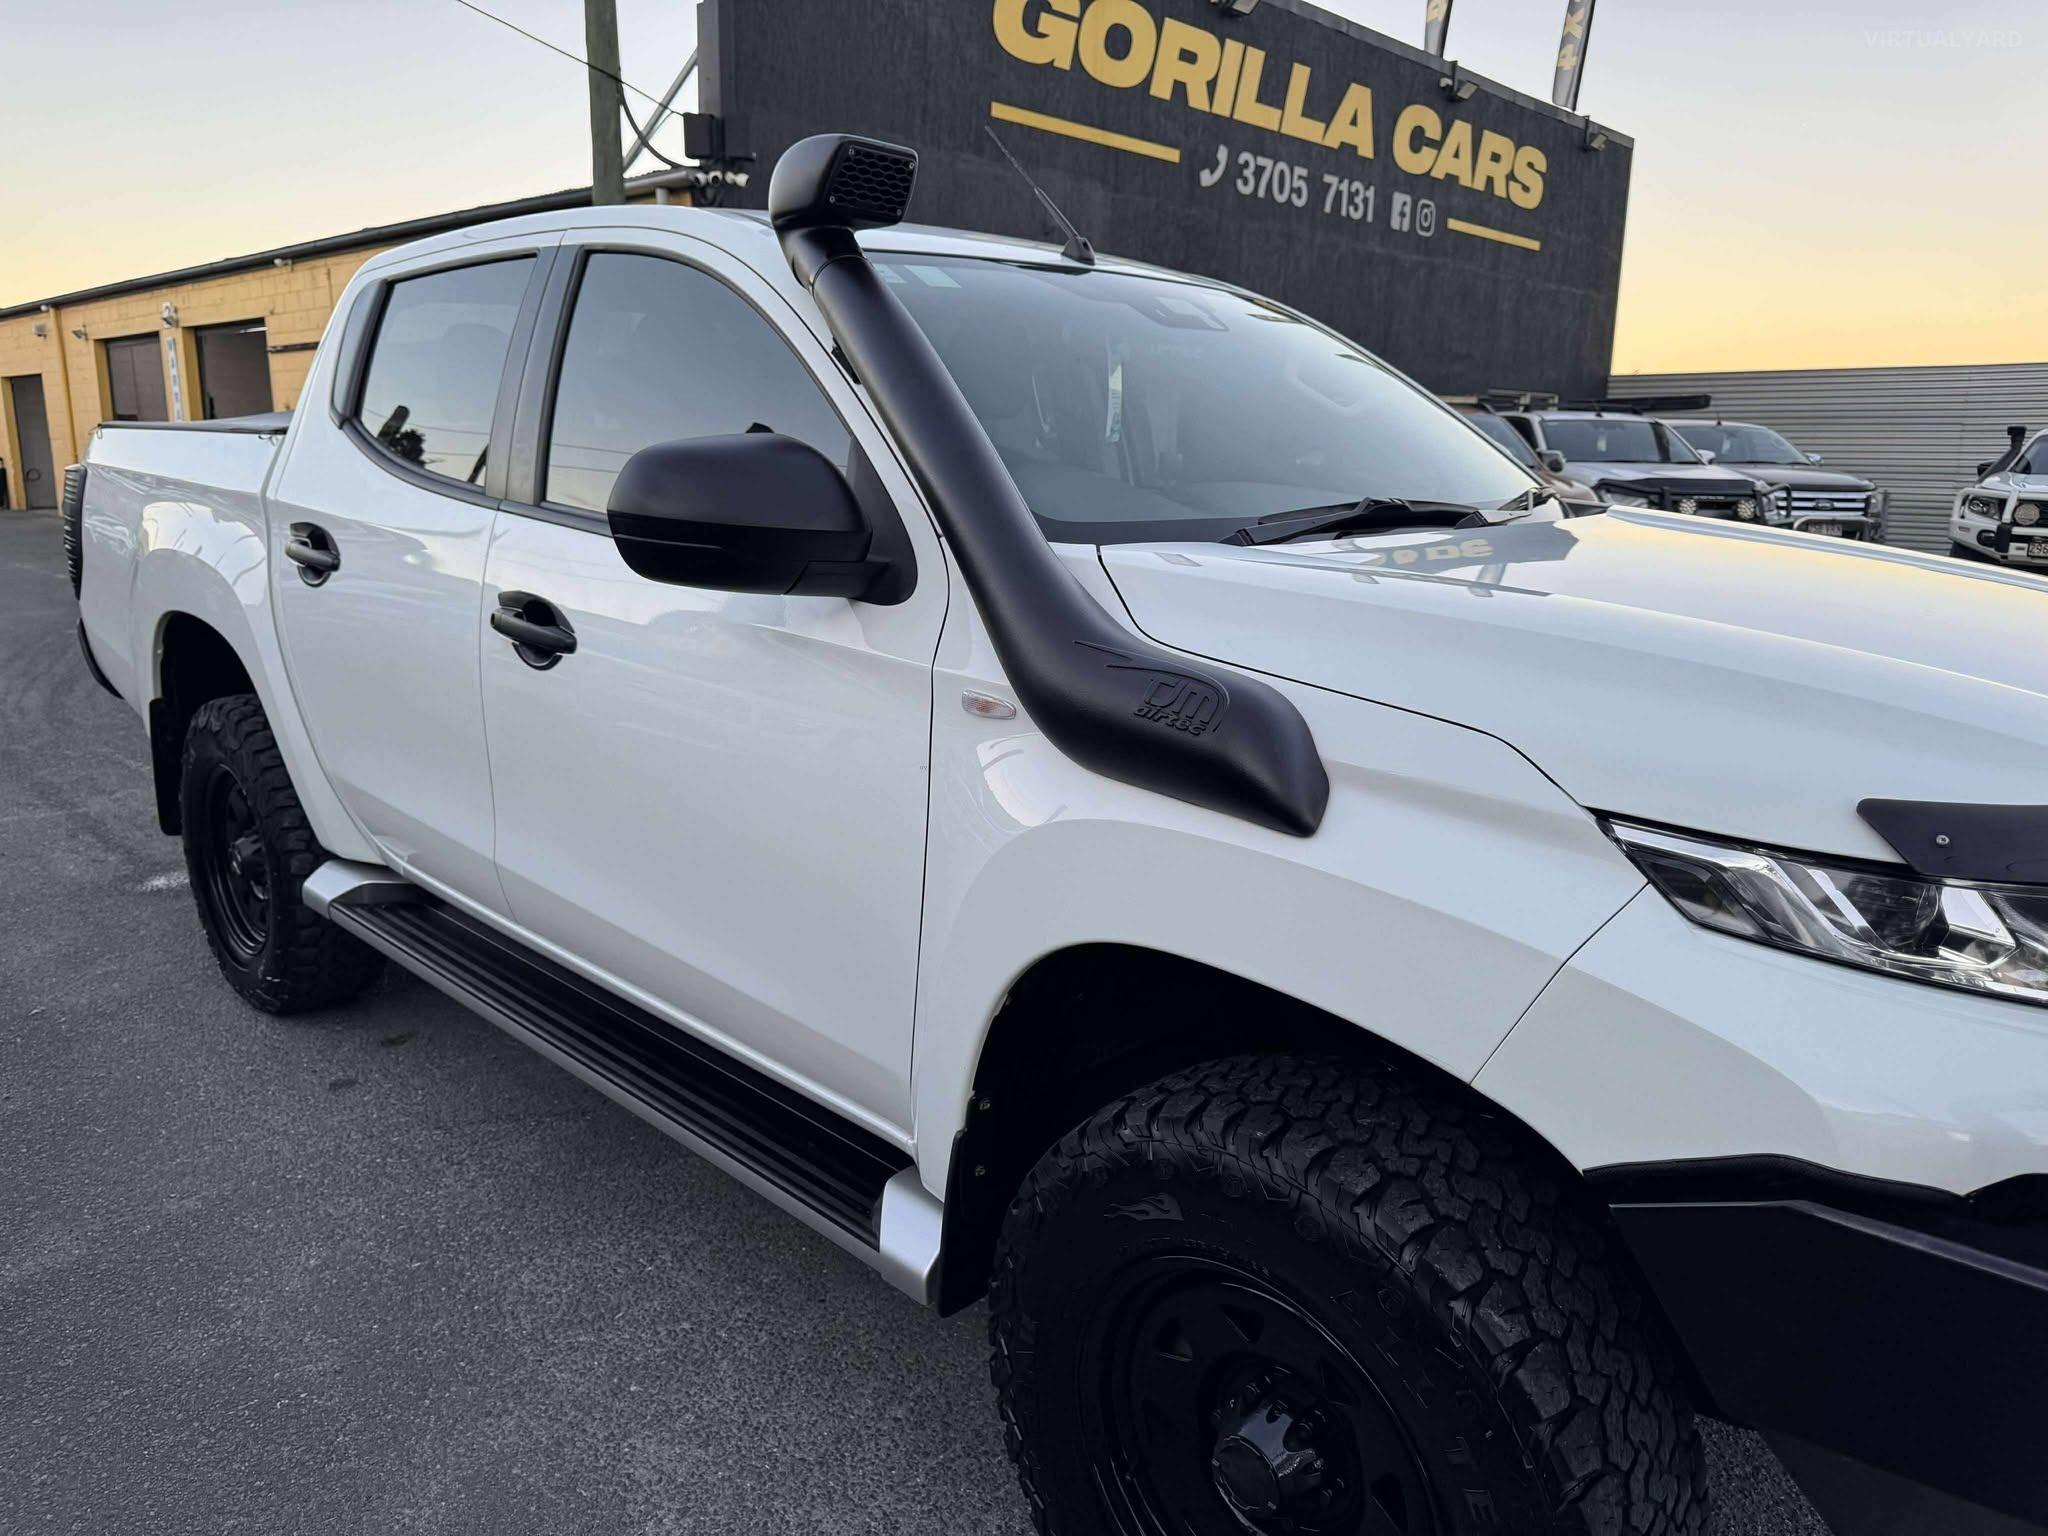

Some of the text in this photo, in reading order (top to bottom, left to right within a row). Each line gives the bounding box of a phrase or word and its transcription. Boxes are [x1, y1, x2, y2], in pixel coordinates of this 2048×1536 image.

[992, 0, 1547, 210] GORILLA CARS
[1236, 152, 1375, 222] 3705 7131
